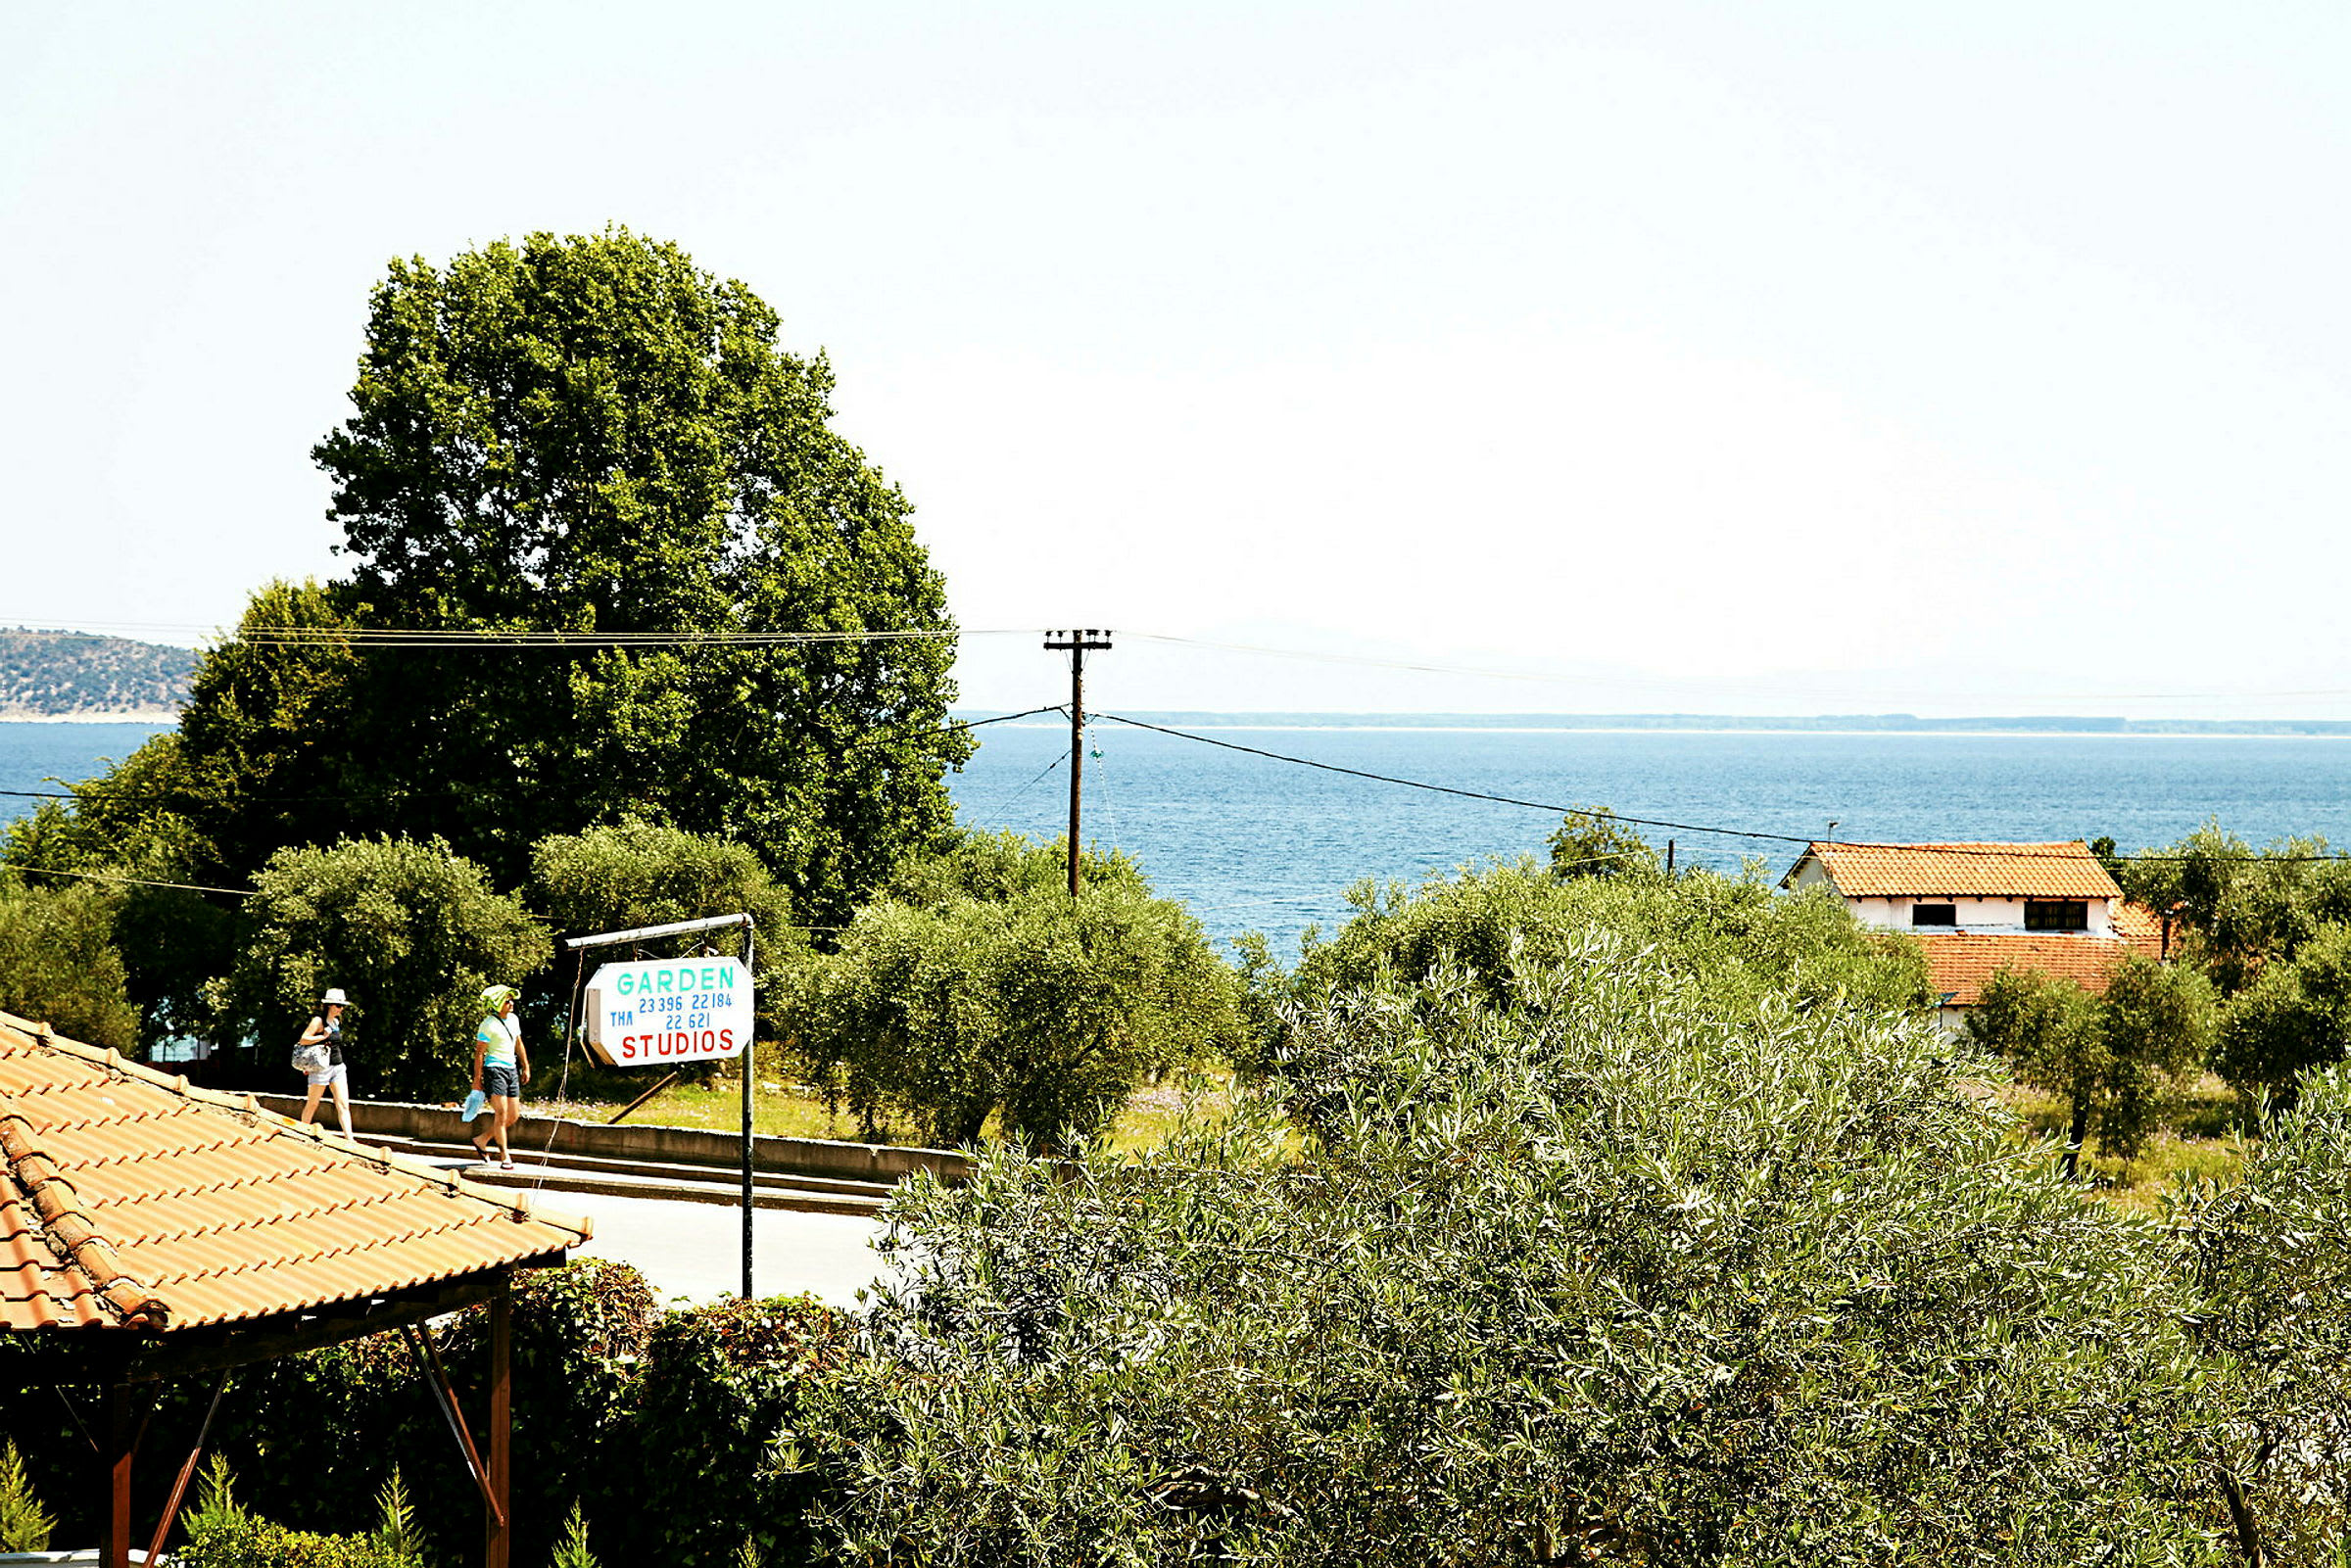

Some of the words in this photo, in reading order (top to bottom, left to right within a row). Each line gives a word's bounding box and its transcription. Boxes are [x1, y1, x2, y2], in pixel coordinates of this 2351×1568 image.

[617, 966, 734, 996] GARDEN
[692, 992, 733, 1010] 22184
[622, 1028, 734, 1059] STUDIOS
